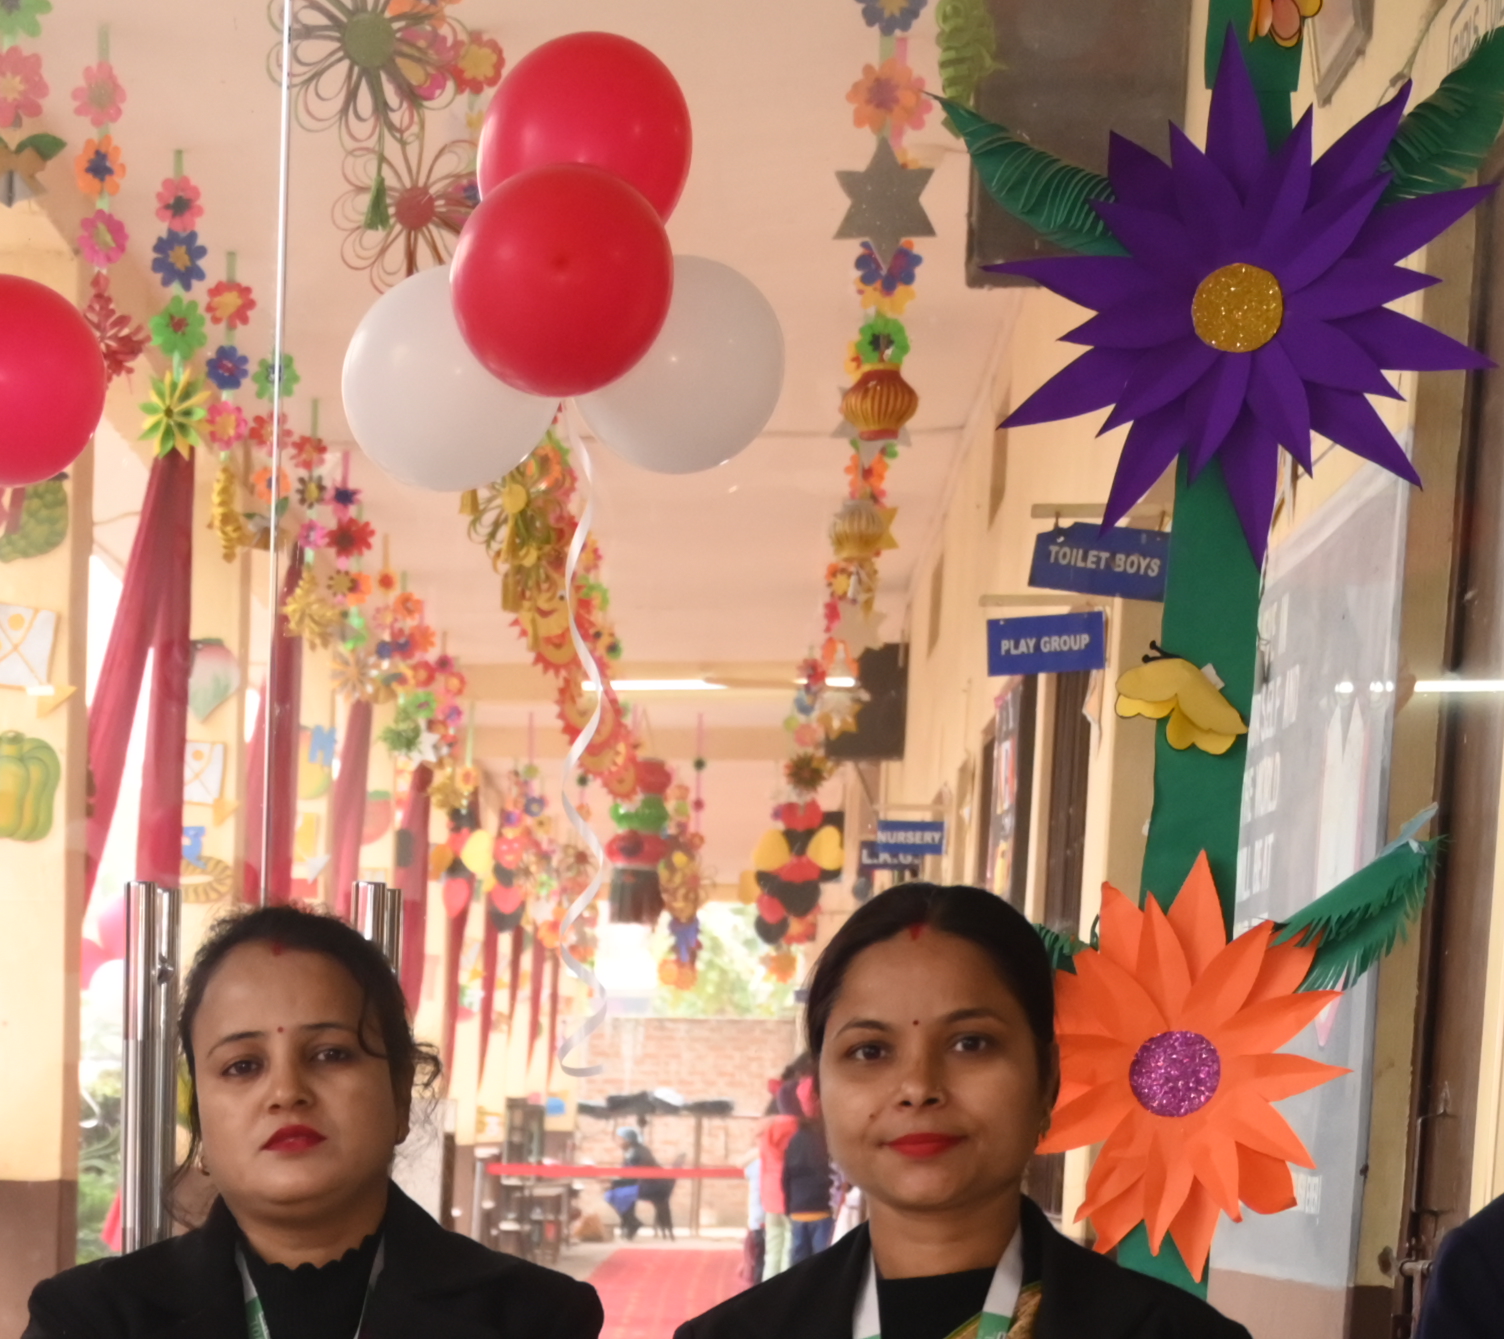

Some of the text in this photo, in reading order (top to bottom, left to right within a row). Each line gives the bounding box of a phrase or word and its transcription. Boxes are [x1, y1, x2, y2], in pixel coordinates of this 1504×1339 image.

[1048, 545, 1160, 577] TOILET BOYS
[1001, 633, 1090, 655] PLAY GROUP
[877, 830, 942, 844] NURSERY
